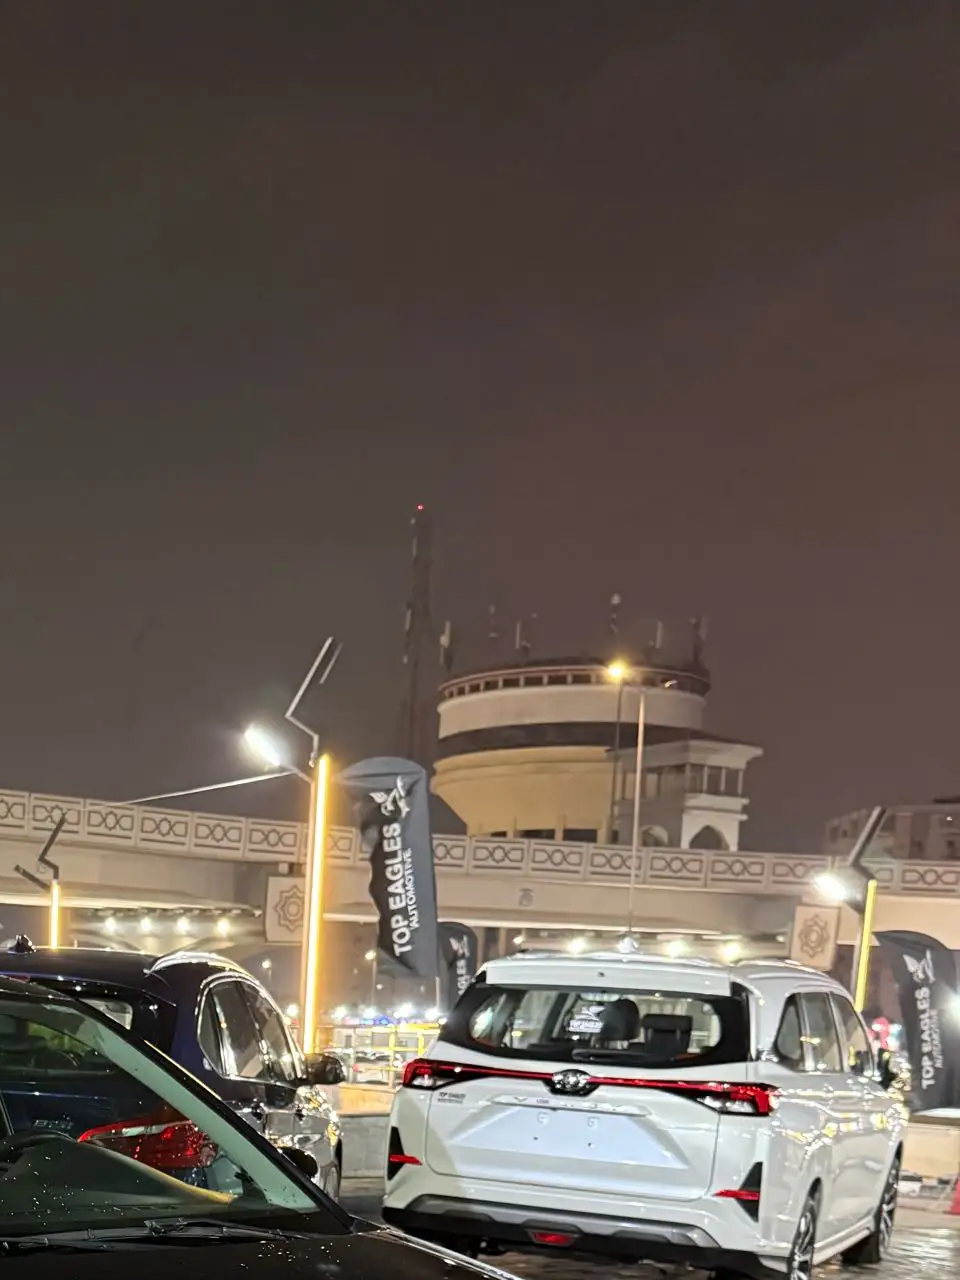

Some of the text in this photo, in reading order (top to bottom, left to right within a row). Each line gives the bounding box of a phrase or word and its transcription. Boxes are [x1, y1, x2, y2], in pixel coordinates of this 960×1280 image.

[382, 822, 413, 957] TOP EAGLES
[403, 848, 420, 930] AUTOMOTIVE
[914, 986, 935, 1090] TOP EAGLES
